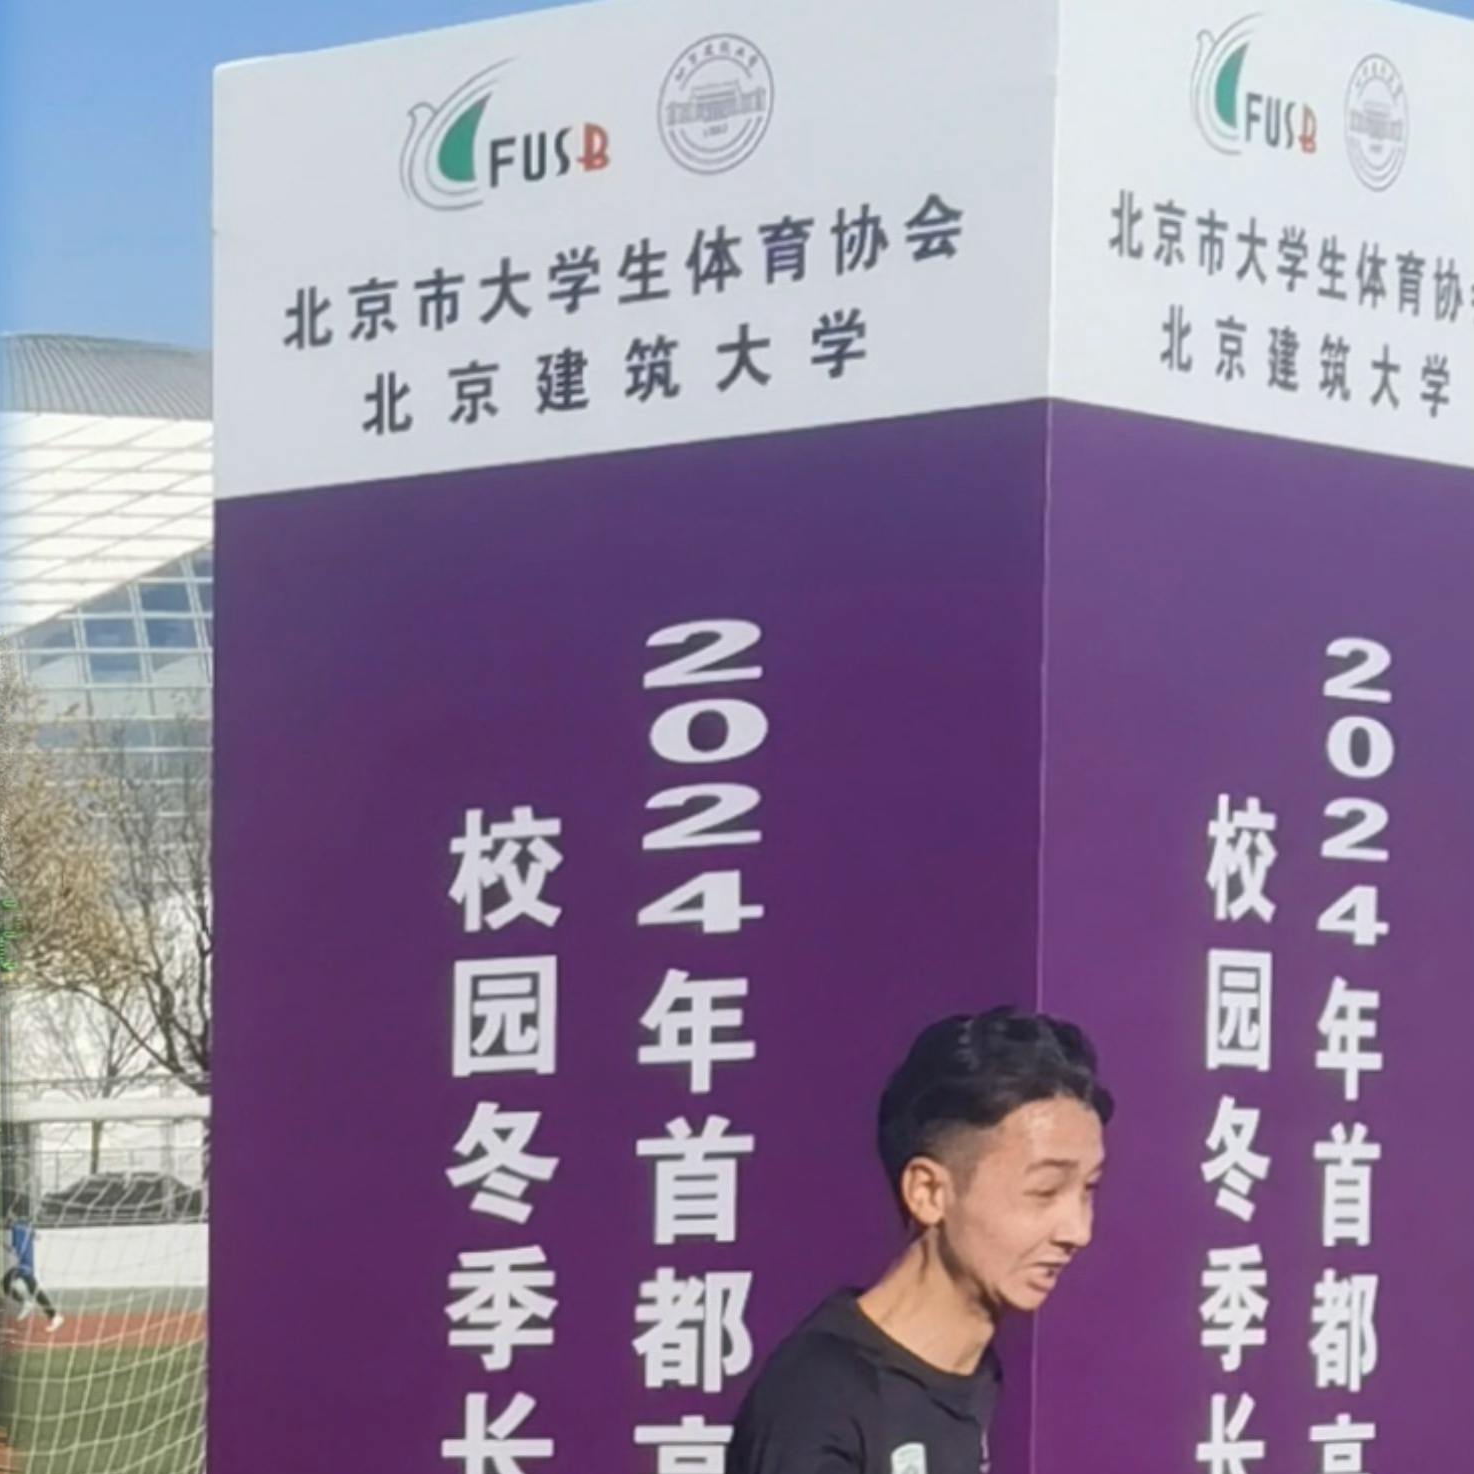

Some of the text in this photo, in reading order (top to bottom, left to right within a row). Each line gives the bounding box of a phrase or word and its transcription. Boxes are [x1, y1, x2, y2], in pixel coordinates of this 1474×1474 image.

[490, 123, 610, 189] FUSB
[1246, 92, 1317, 154] FUSB
[283, 193, 964, 350] 北京市大学生体育协会
[1108, 189, 1474, 323] 北京市大学生体育协
[362, 307, 866, 435] 北京建筑大学
[1159, 304, 1452, 418] 北京建筑大学
